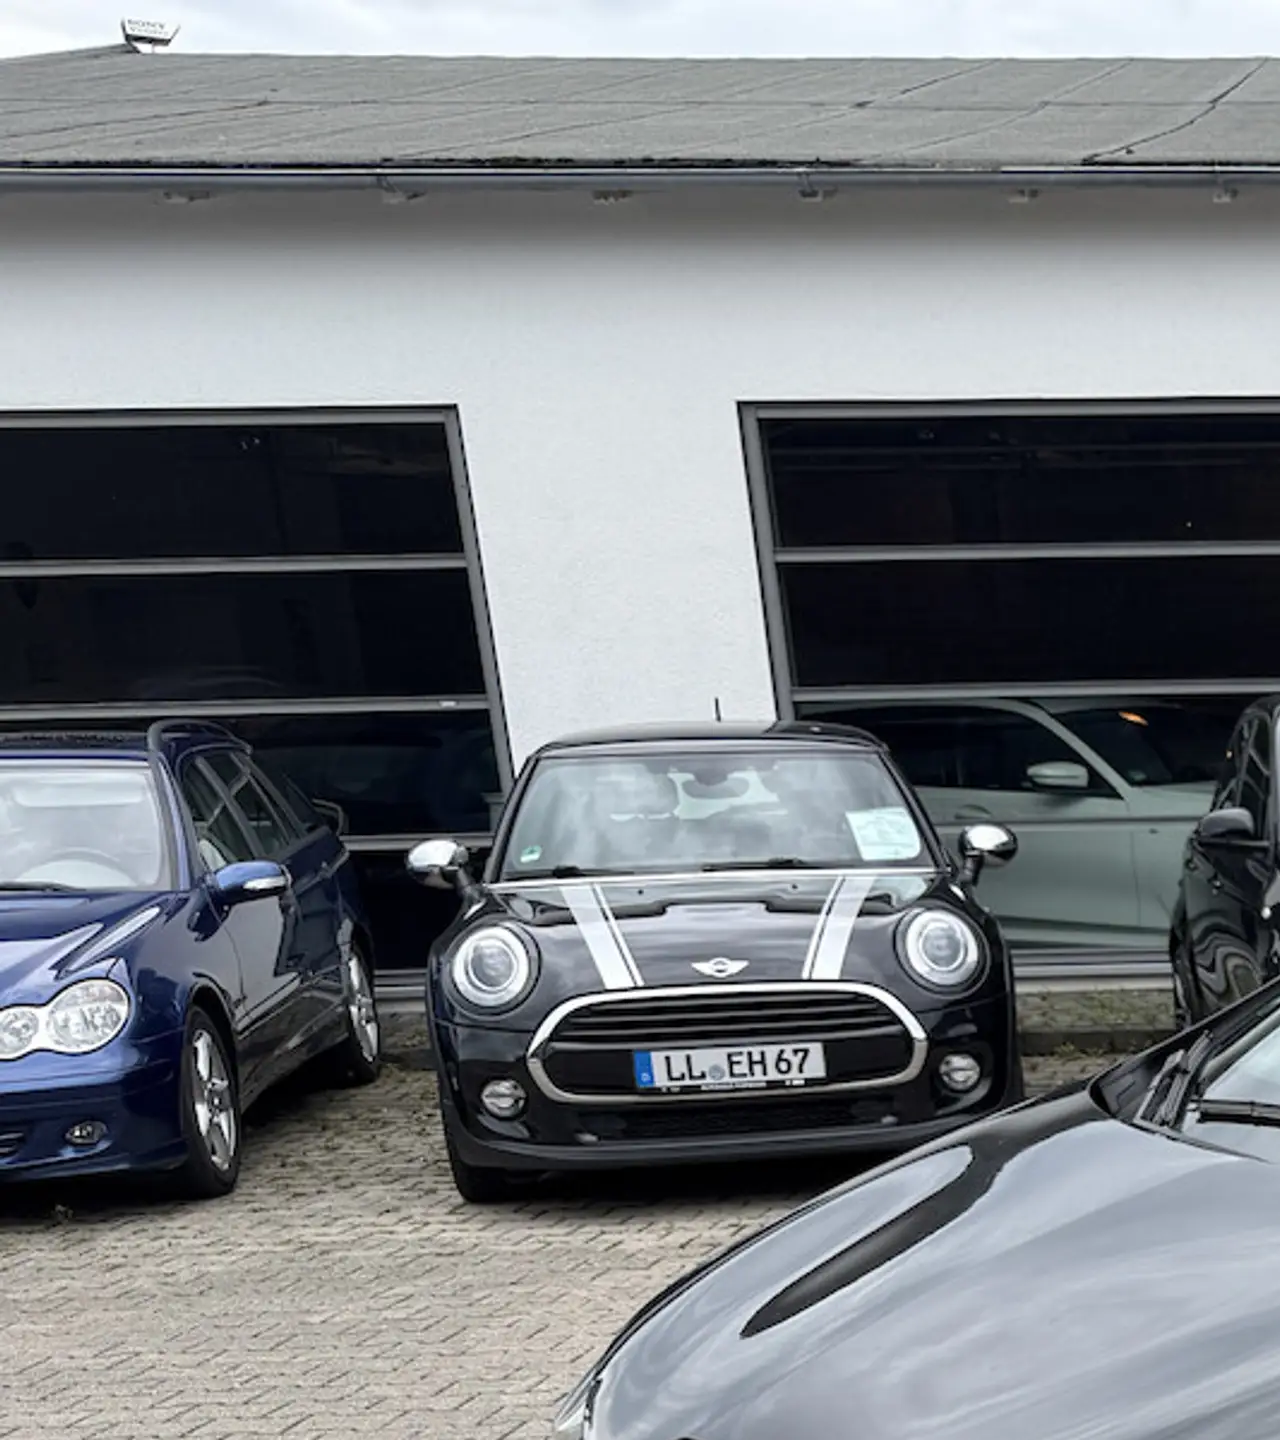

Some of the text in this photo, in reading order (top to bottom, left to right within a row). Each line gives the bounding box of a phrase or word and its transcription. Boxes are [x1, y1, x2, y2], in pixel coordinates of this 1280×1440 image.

[664, 1048, 811, 1082] LL EH 67
